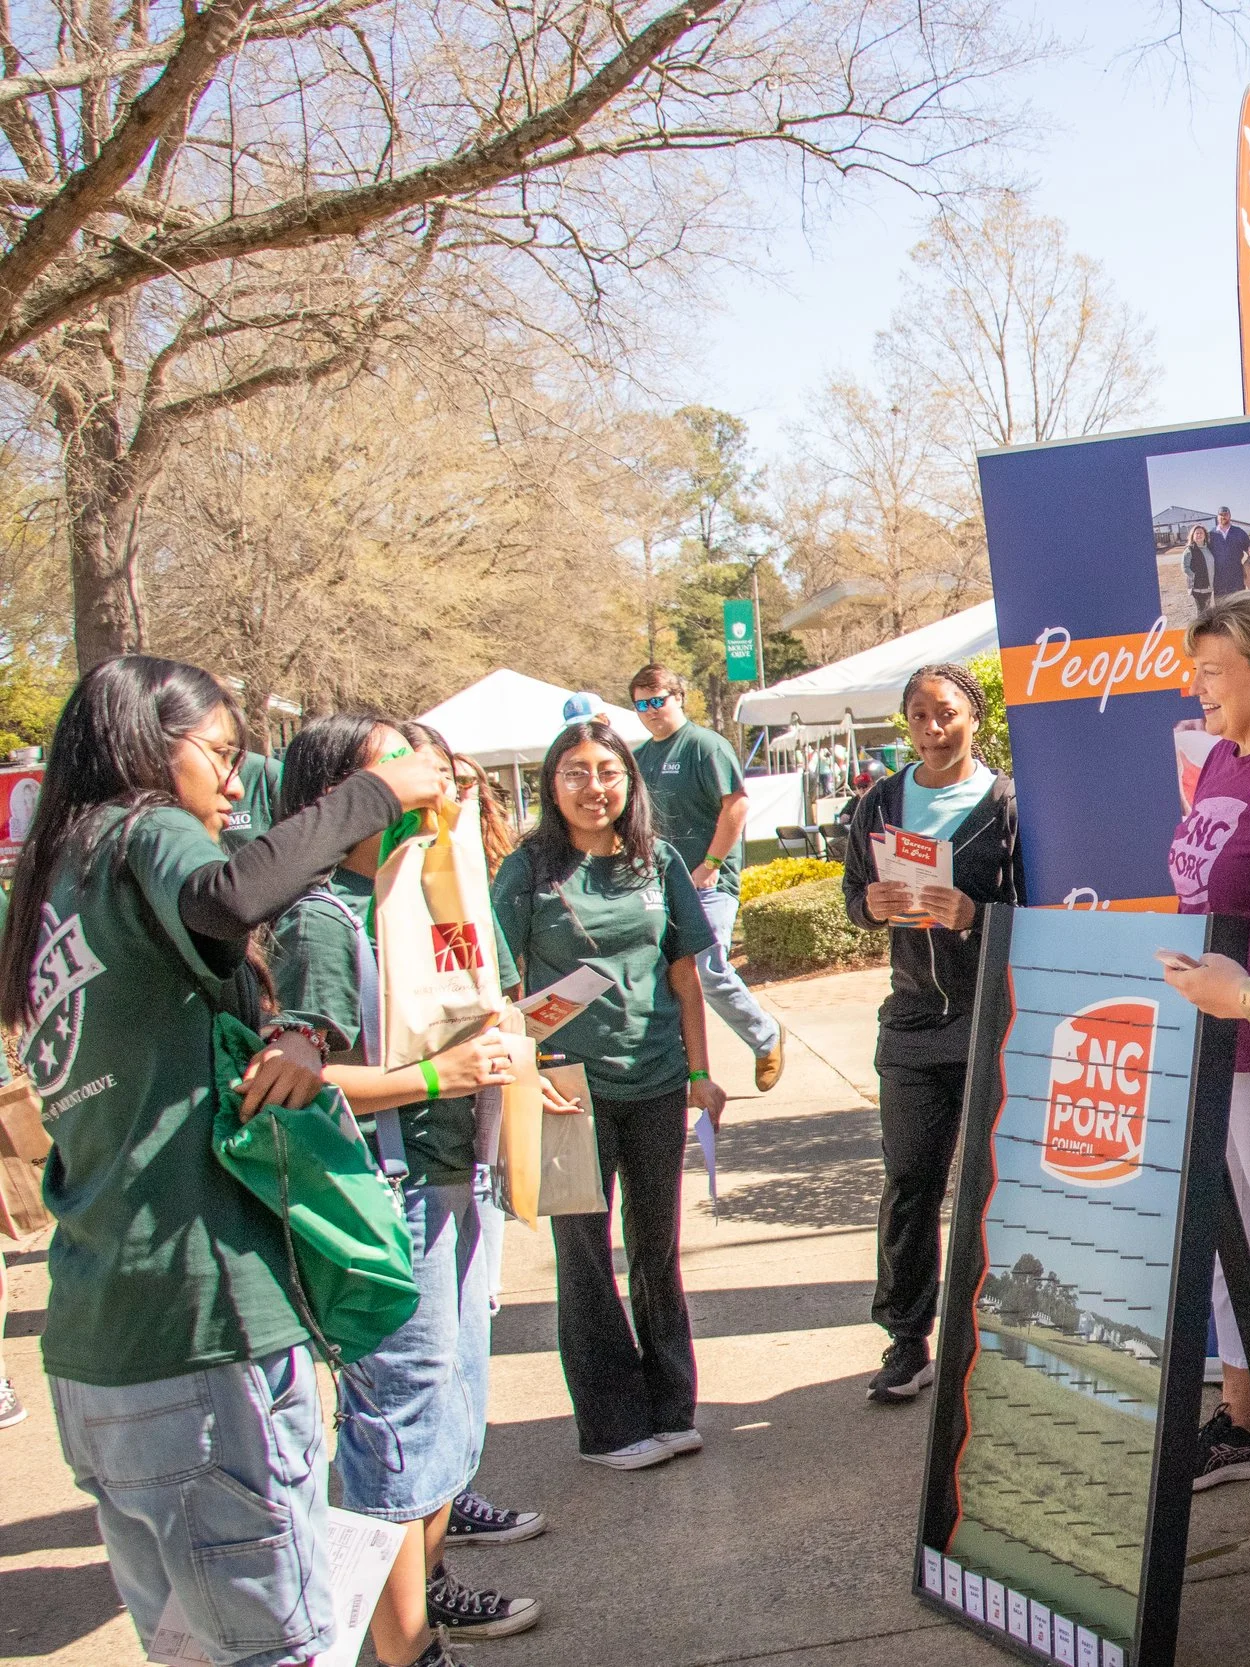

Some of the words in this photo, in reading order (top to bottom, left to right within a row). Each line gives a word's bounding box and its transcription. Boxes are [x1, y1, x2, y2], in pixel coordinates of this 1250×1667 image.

[727, 644, 753, 652] MOUNT
[1026, 615, 1190, 713] People.
[229, 813, 251, 825] MO
[901, 836, 932, 852] Careers
[1186, 815, 1231, 851] NC
[901, 846, 909, 854] in
[910, 848, 931, 860] Pork
[1168, 847, 1209, 884] PORK
[1086, 1037, 1144, 1095] NC
[81, 1073, 118, 1099] OLIVE
[1053, 1094, 1137, 1146] PORK
[1051, 1136, 1096, 1159] COUNCIL
